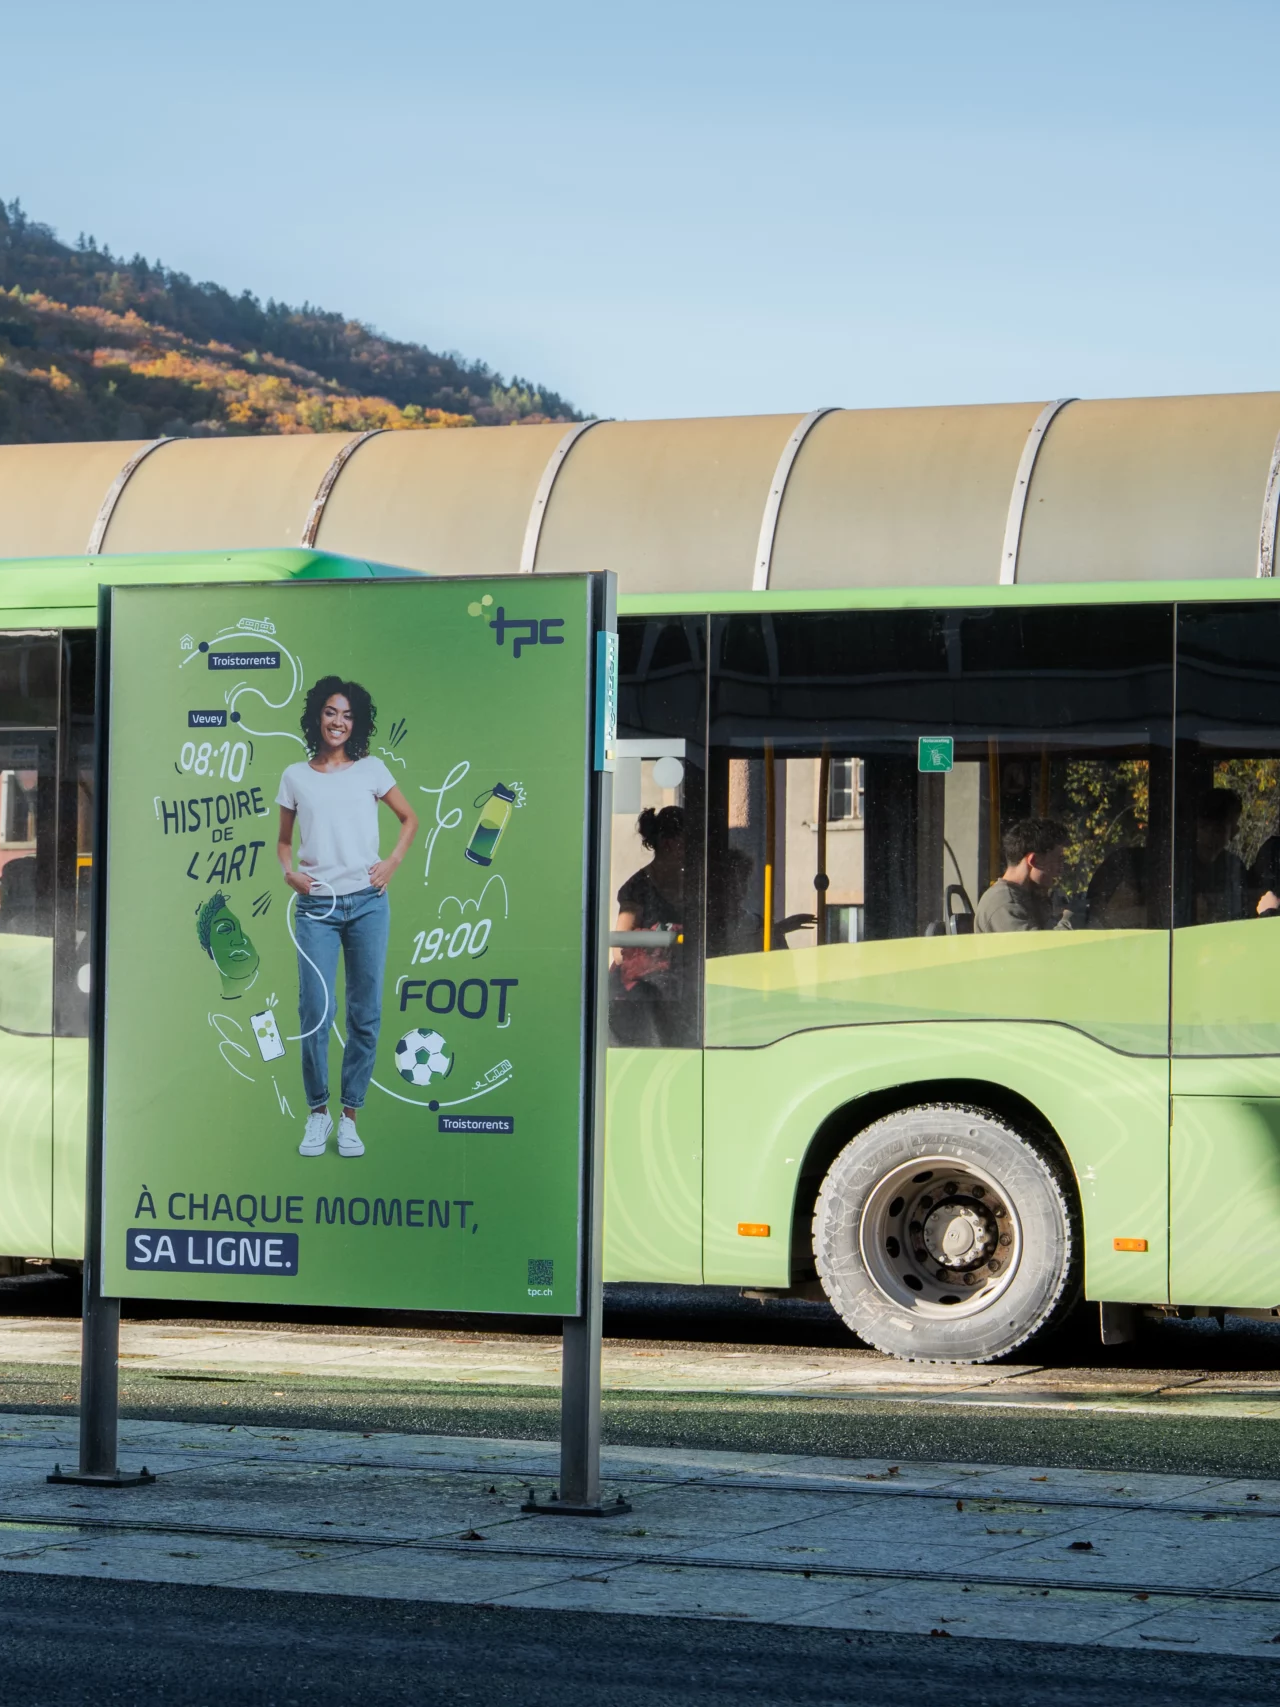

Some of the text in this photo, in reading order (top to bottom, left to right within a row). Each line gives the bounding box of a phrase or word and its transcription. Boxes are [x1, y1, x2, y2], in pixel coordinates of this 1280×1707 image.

[489, 607, 564, 658] tpc
[212, 653, 276, 668] Troistorrents
[192, 711, 222, 726] Vevey
[180, 741, 248, 783] 08:10
[162, 787, 266, 835] HISTOIRE
[211, 827, 234, 843] DE
[187, 841, 265, 885] L'ART
[411, 918, 492, 965] 19:00
[399, 978, 519, 1023] FOOT
[443, 1118, 510, 1130] Troistorrents
[134, 1184, 478, 1234] À CHAQUE MOMENT,
[133, 1234, 291, 1268] SA LIGNE.
[527, 1288, 553, 1298] tpc.ch
